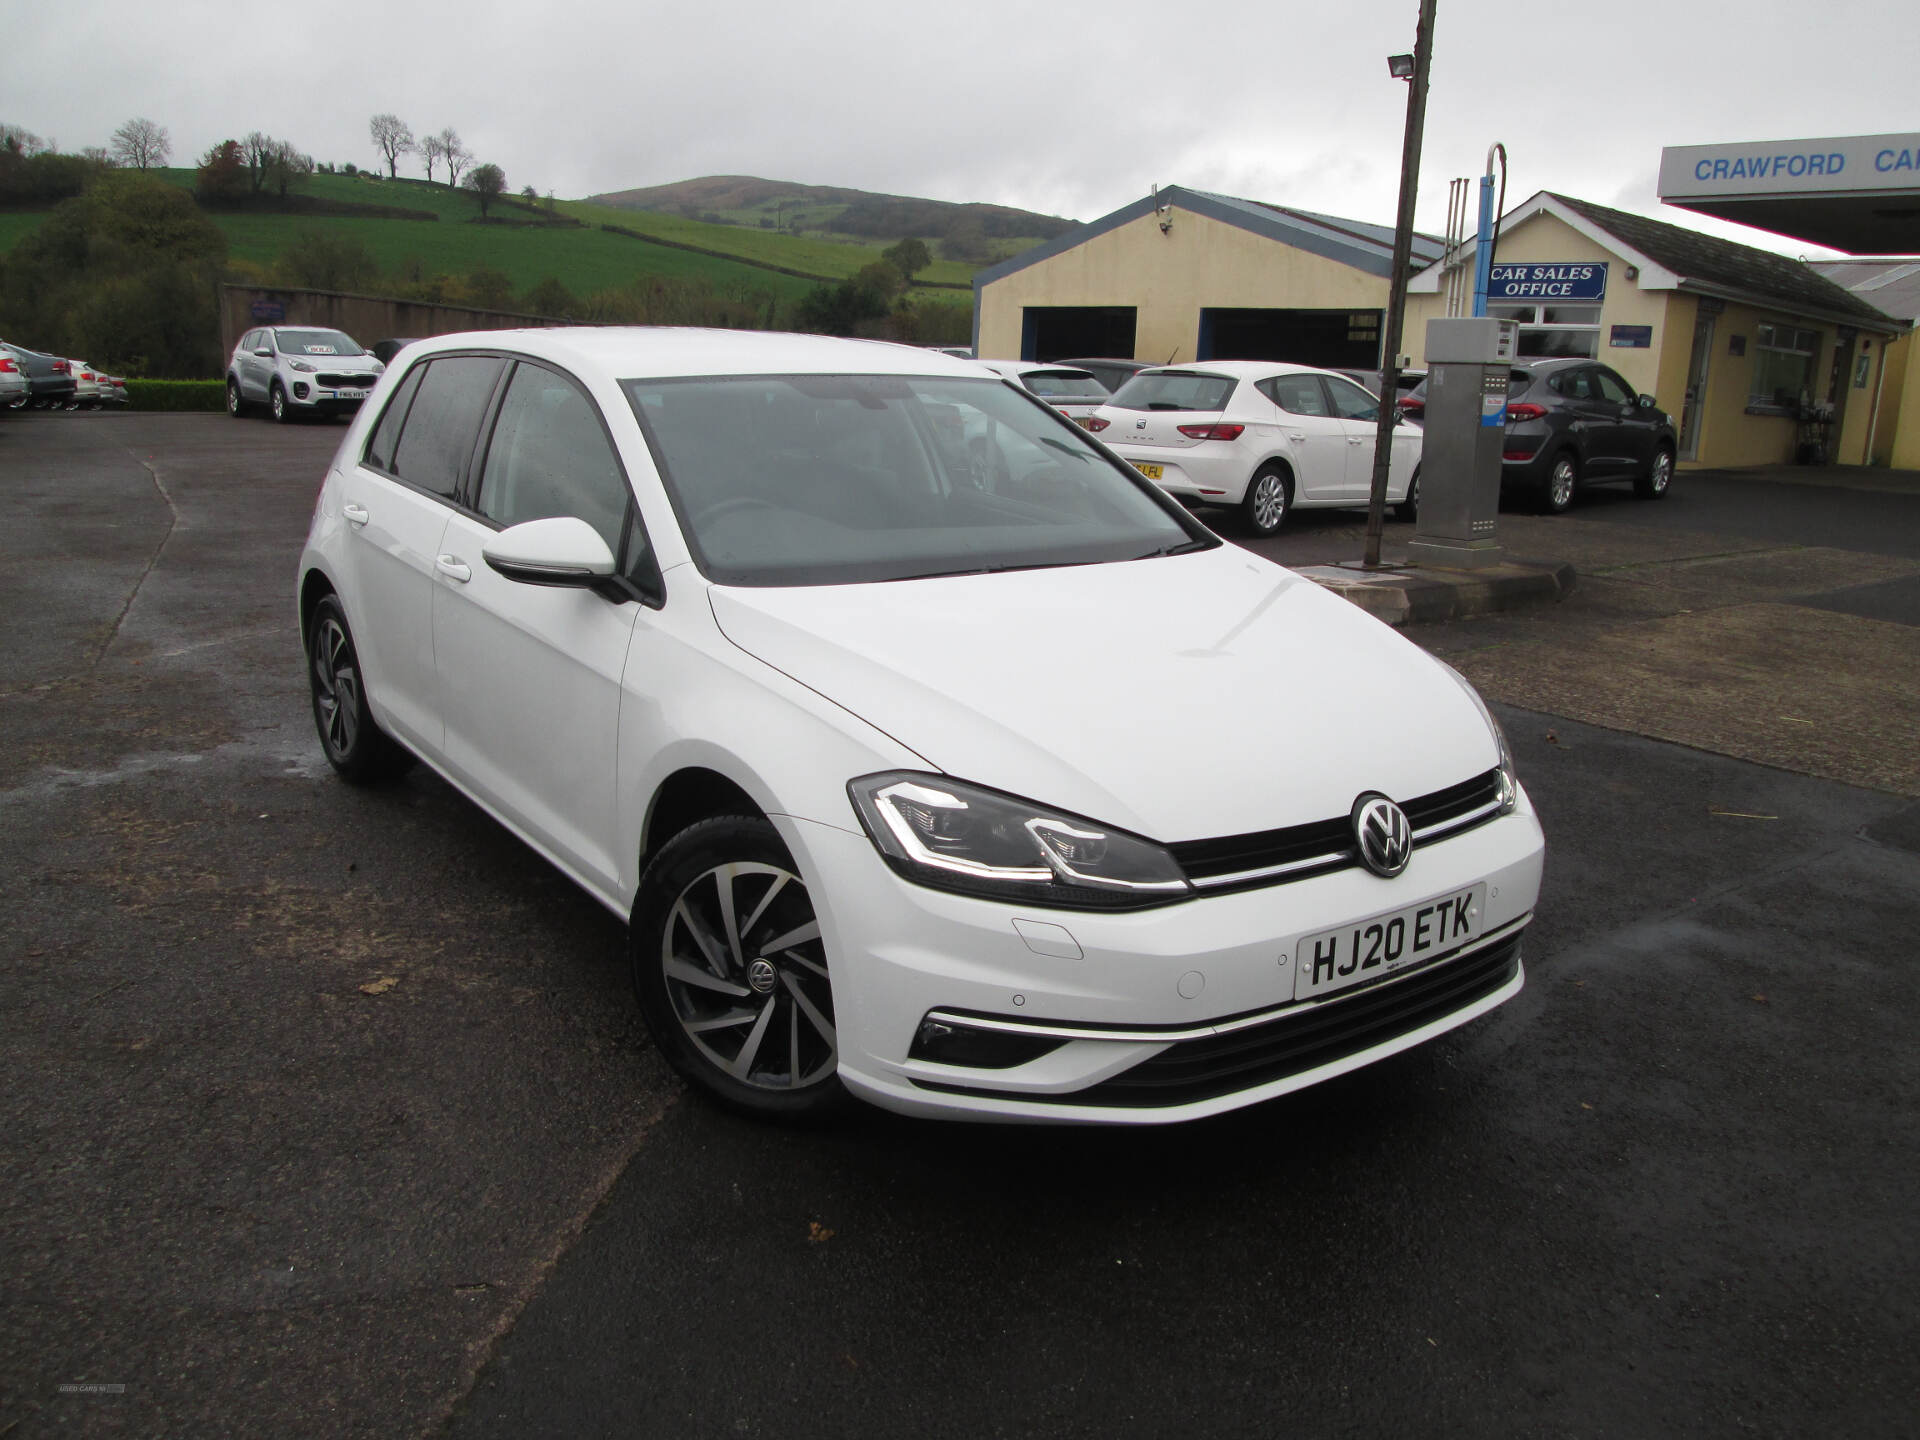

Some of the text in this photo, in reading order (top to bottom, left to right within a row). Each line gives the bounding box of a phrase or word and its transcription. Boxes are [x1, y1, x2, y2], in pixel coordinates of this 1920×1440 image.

[1695, 149, 1920, 181] CRAWFORD CA
[1491, 267, 1592, 280] CAR SALES
[1505, 283, 1573, 295] OFFICE
[1312, 917, 1404, 985] HJ20
[1413, 893, 1472, 952] ETK
